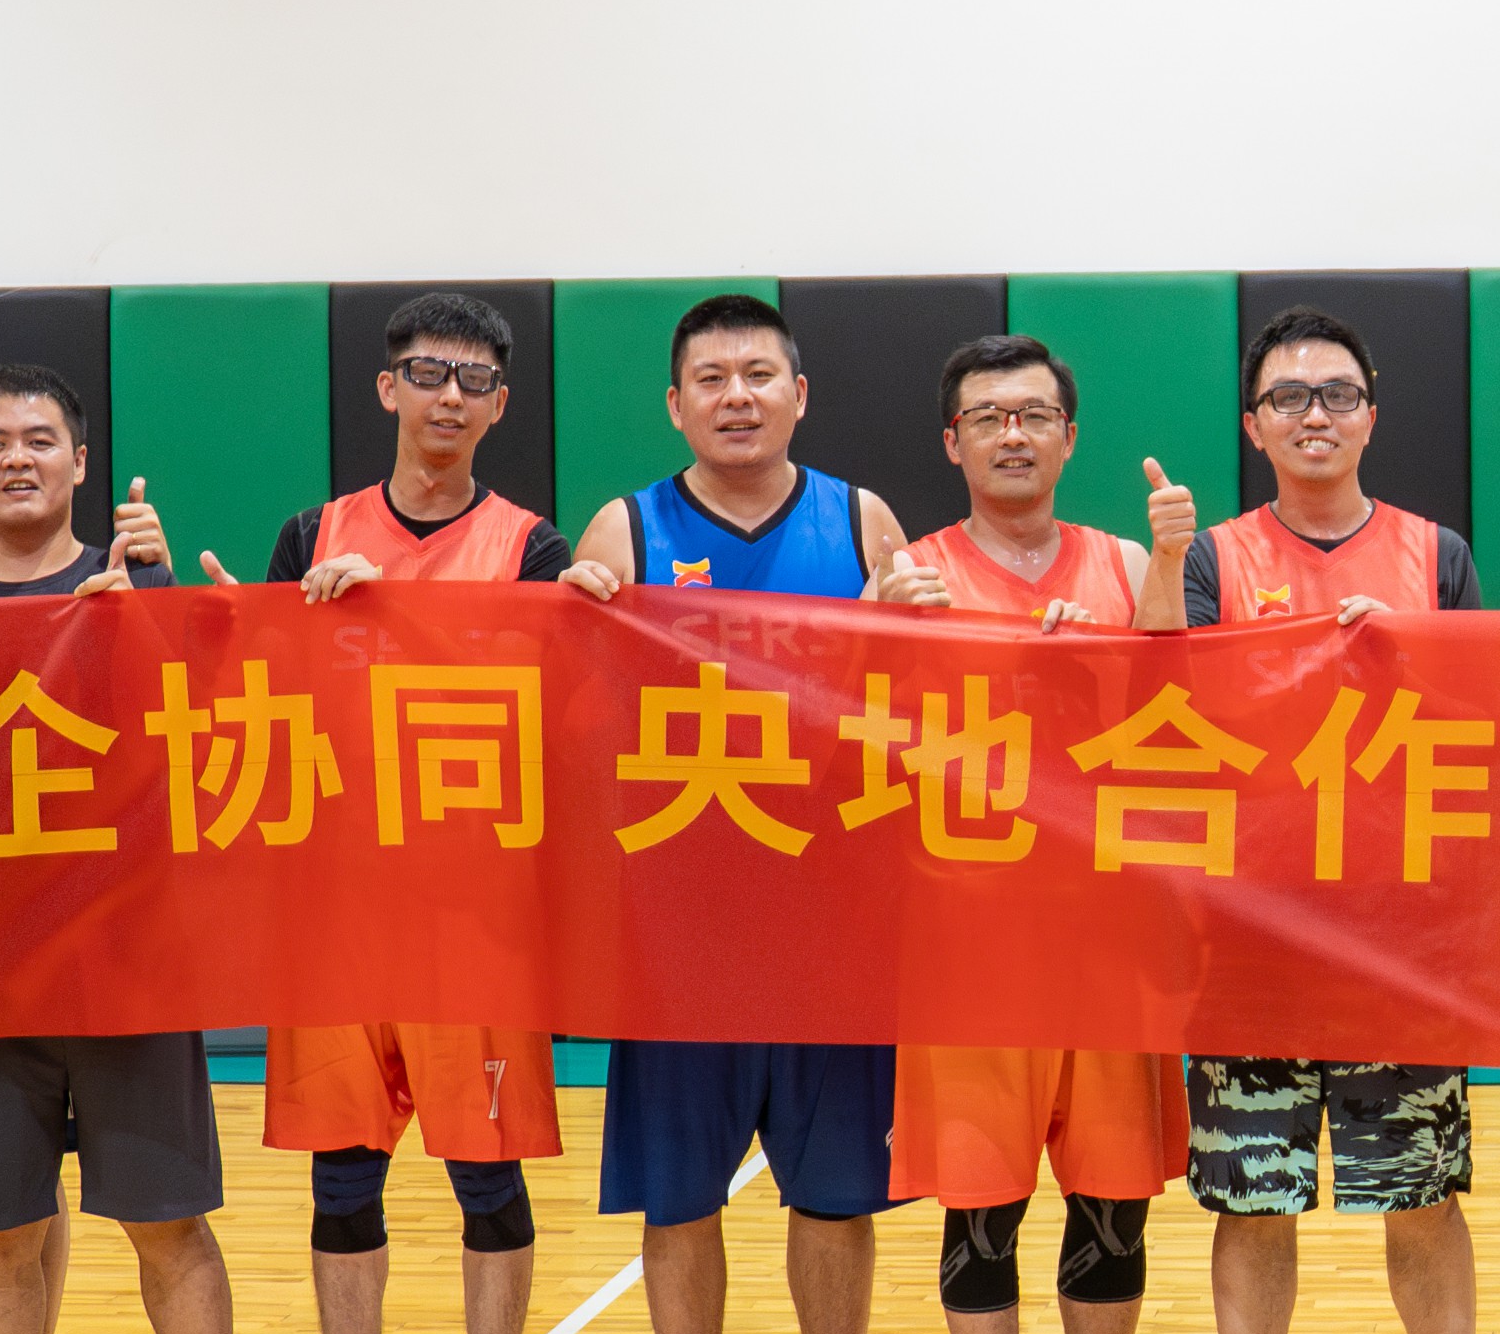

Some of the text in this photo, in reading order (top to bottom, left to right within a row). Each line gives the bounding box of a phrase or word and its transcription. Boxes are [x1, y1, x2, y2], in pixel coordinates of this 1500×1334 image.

[614, 661, 1496, 884] 央地合作
[484, 1059, 507, 1120] 7
